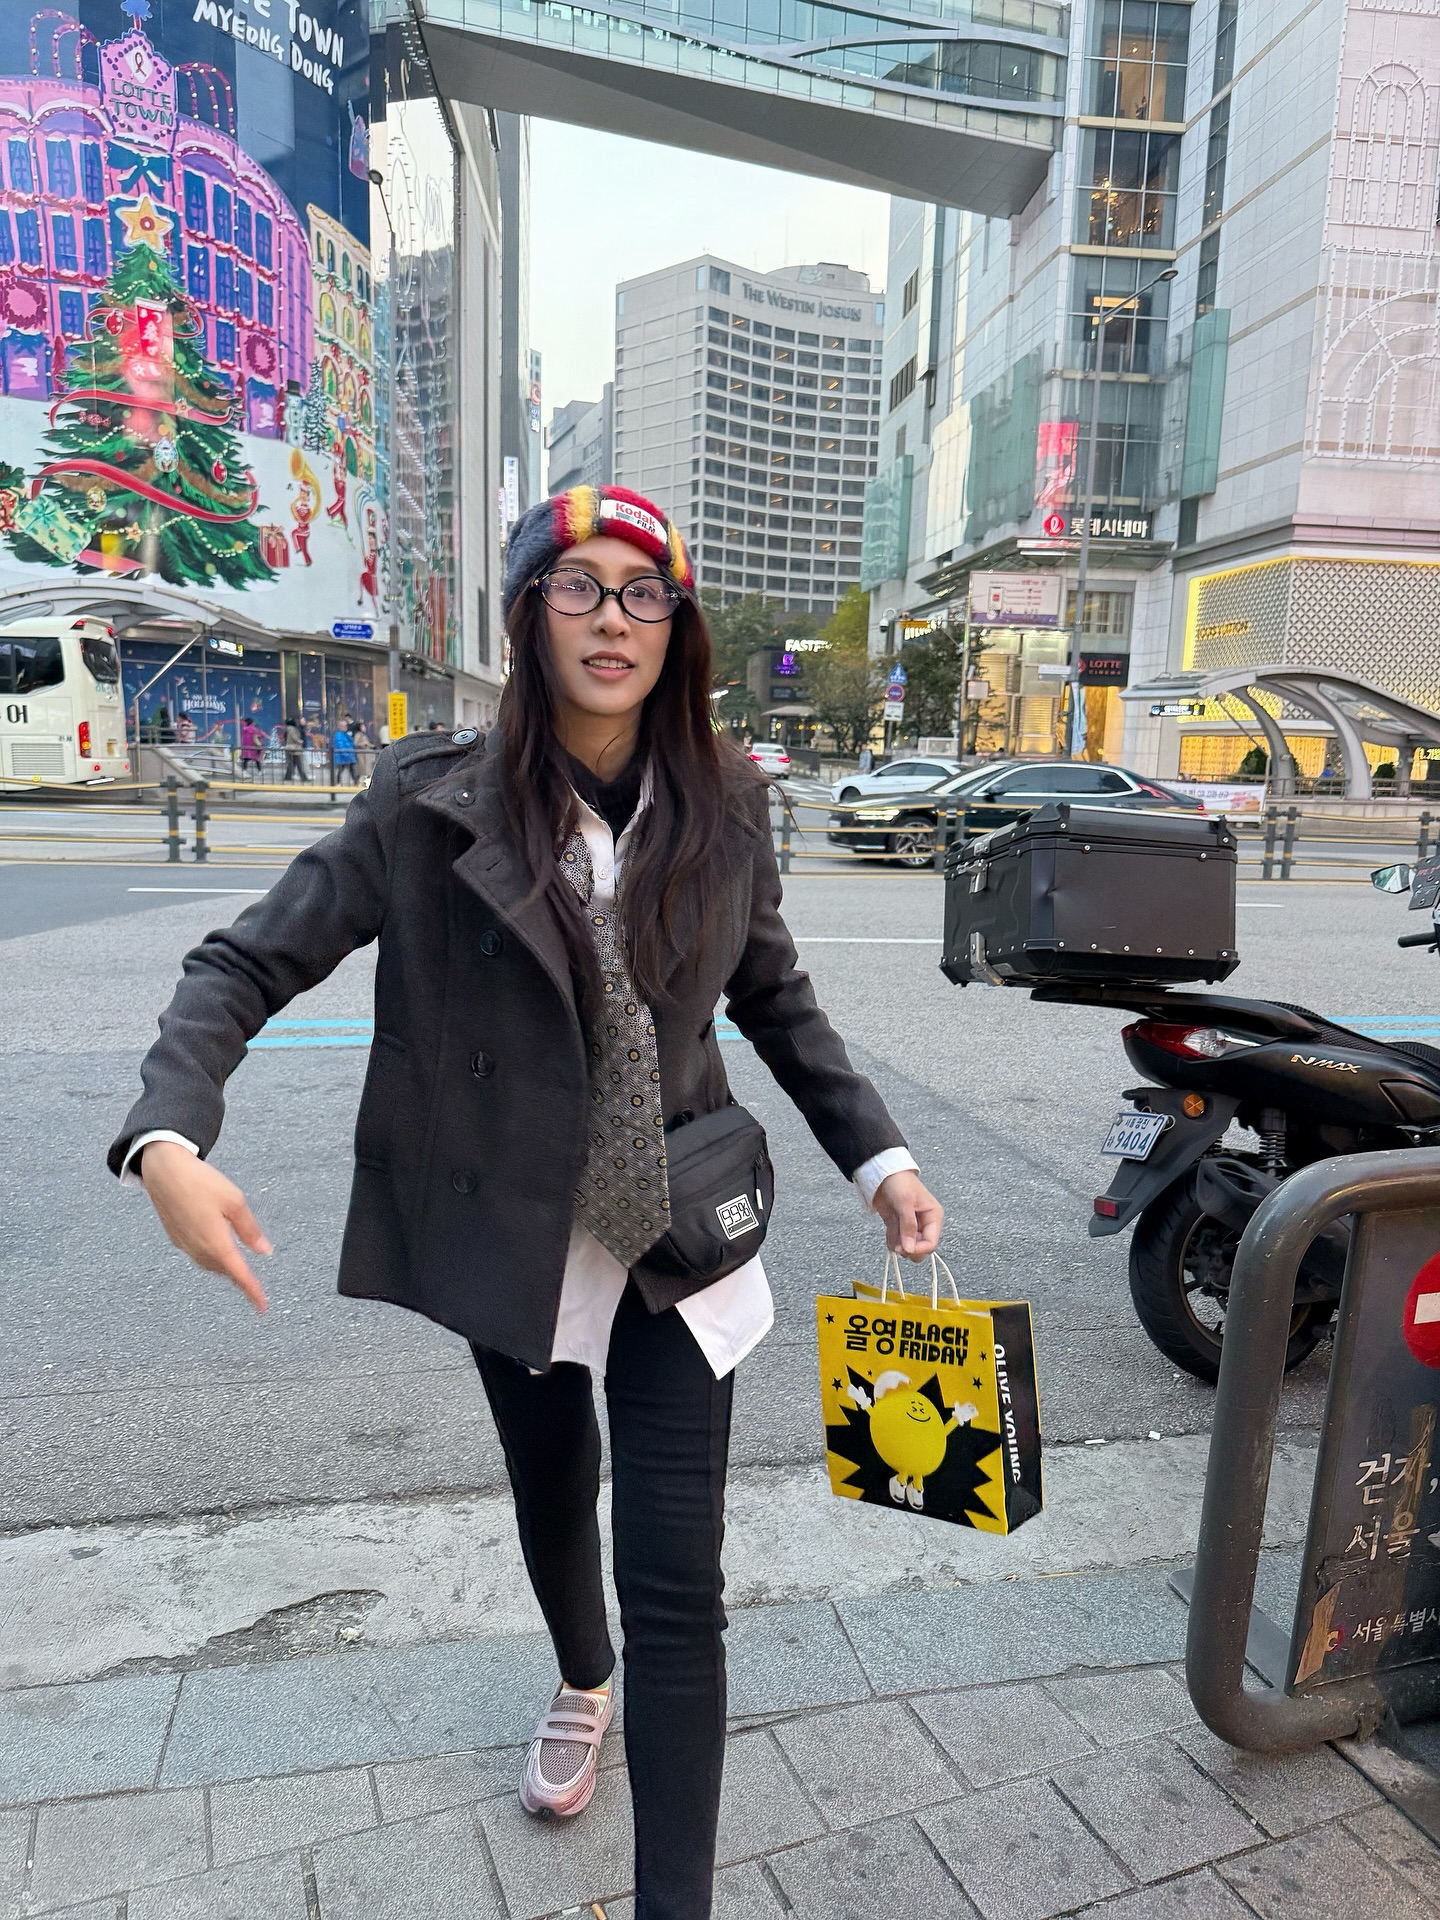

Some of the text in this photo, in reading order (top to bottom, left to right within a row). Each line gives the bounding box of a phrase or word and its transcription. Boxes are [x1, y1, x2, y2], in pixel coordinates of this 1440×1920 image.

[193, 0, 334, 96] MYEONG DONG
[284, 0, 344, 68] TOWN
[111, 78, 172, 110] LOTTE
[109, 98, 174, 127] TOWN
[742, 283, 862, 321] THE WESTIN JOSUN
[615, 503, 656, 527] Kodak
[636, 519, 656, 534] FILM
[1089, 660, 1122, 668] LOTTE
[1289, 1054, 1362, 1074] NMAX
[1114, 1130, 1151, 1152] 9404
[721, 1202, 751, 1227] 99%
[844, 1315, 897, 1355] 올영
[900, 1319, 969, 1347] BLACK
[899, 1339, 968, 1367] FRIDAY
[993, 1343, 1012, 1405] OLIVE
[1344, 1510, 1420, 1561] 서울
